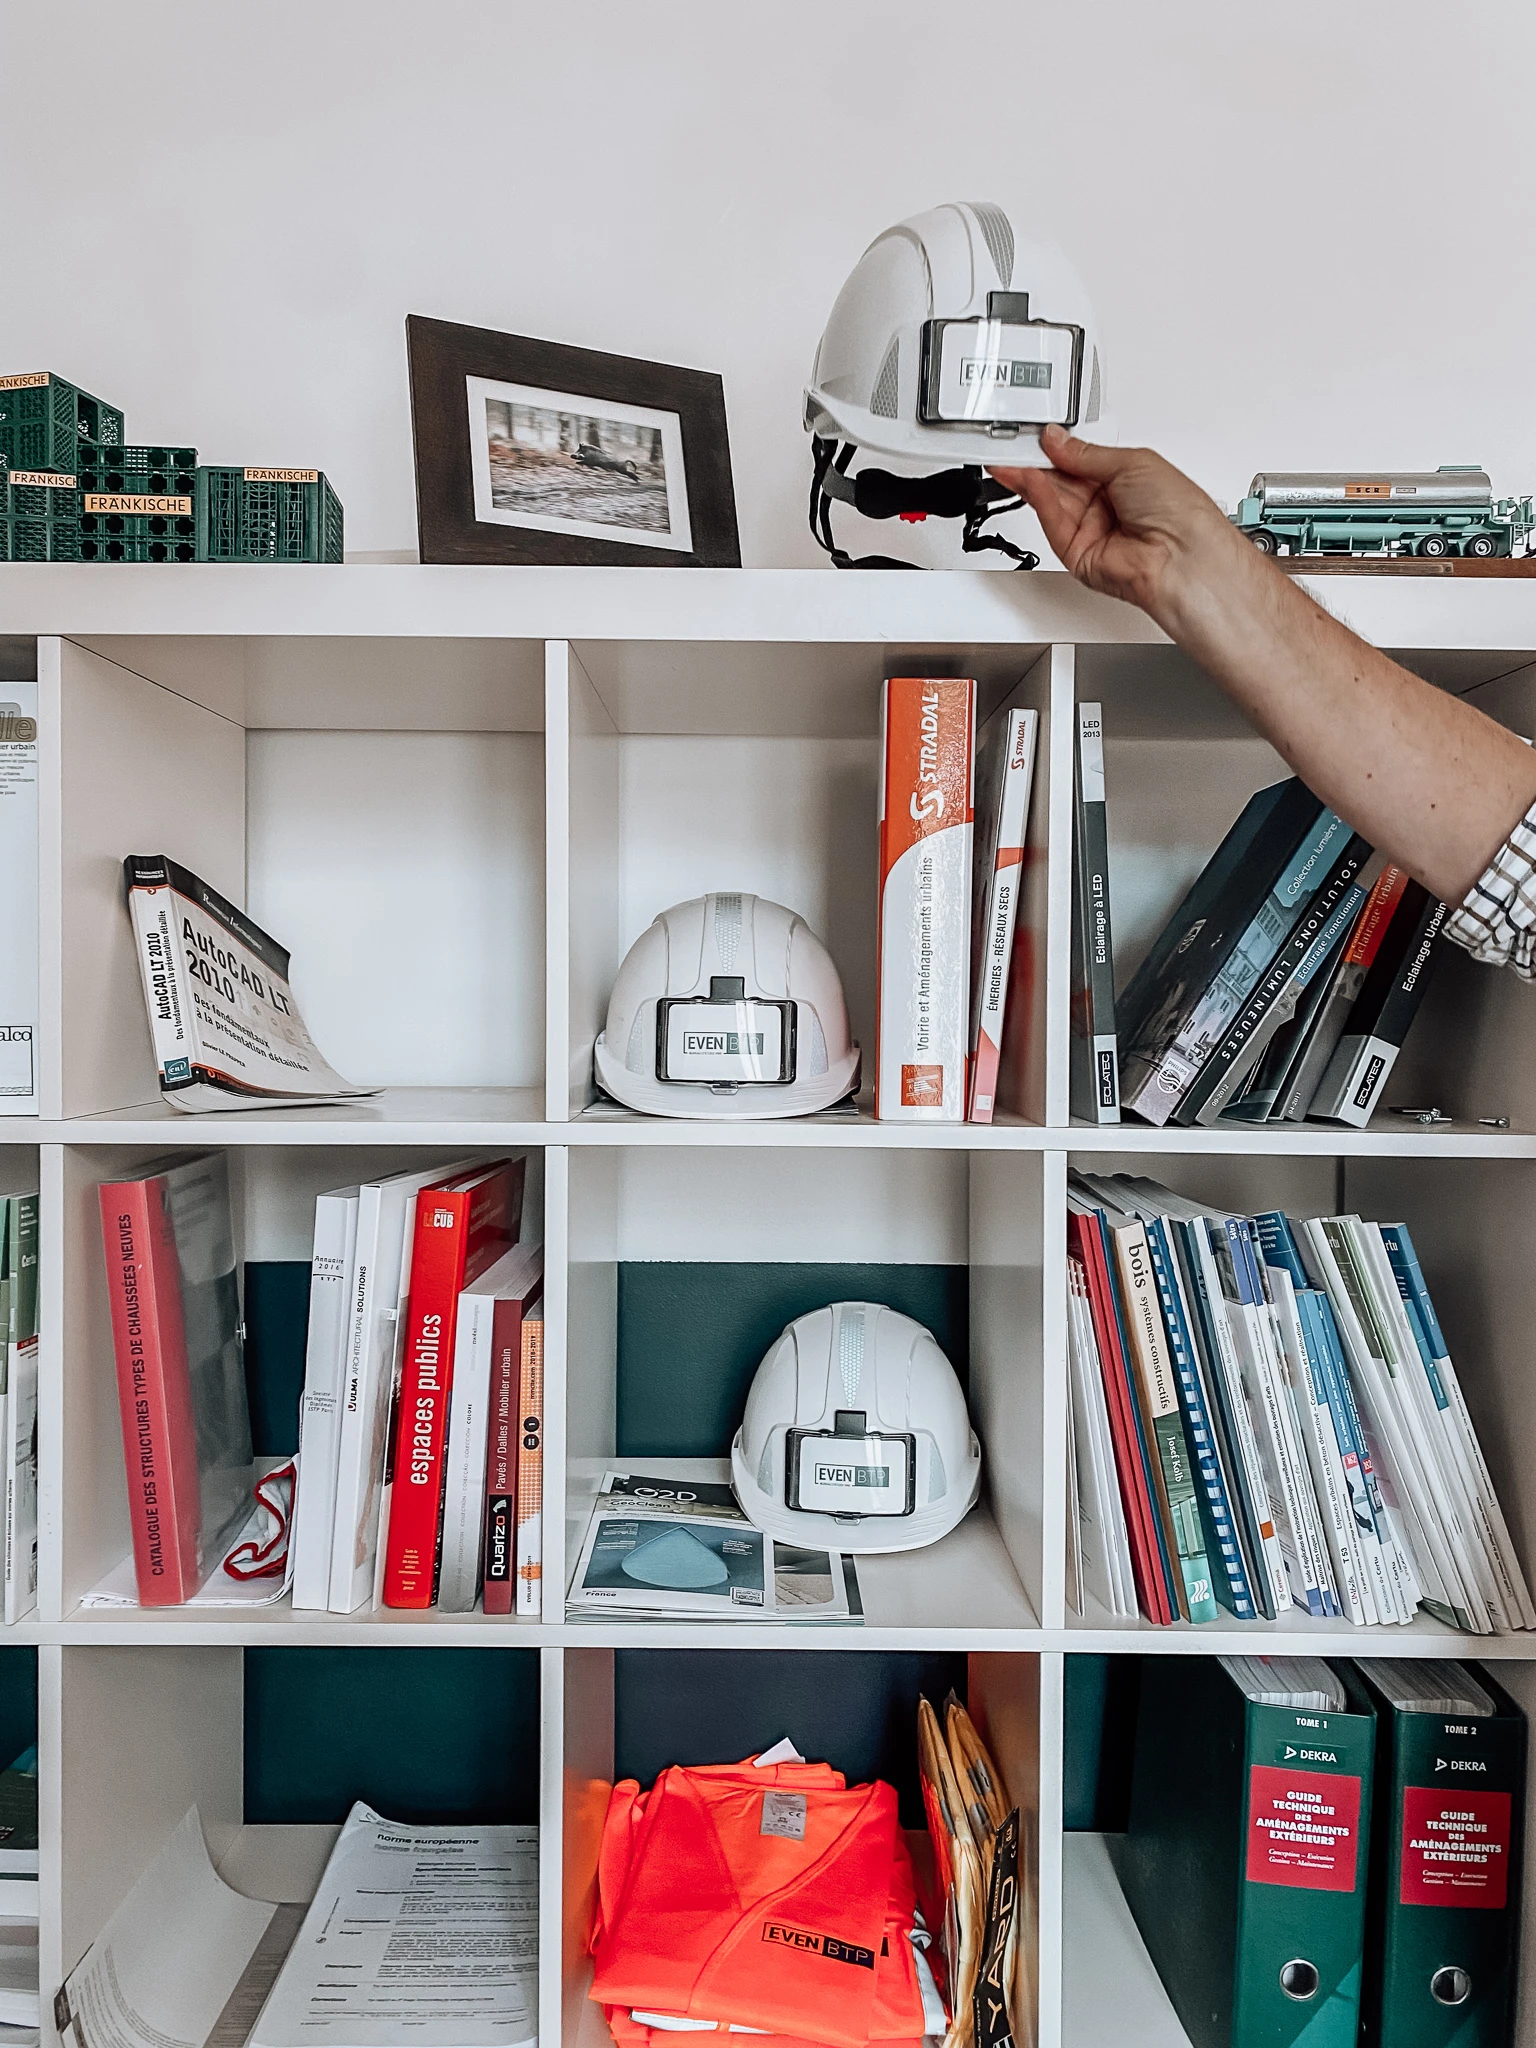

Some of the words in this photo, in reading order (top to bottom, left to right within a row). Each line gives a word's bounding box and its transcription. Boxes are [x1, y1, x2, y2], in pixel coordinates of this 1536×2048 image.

[0, 376, 46, 388] ÄNKISCHE
[965, 363, 1008, 381] EVEN
[1013, 365, 1048, 382] BTP
[246, 469, 314, 481] FRÄNKISCHE
[90, 497, 186, 512] FRÄNKISCHE
[1083, 721, 1100, 729] LED
[919, 692, 939, 784] STRADAL
[1015, 720, 1026, 756] STRADAL
[1287, 853, 1318, 895] Collection
[1314, 823, 1337, 855] lumière
[920, 857, 933, 901] urbains
[1092, 874, 1103, 899] LED
[999, 886, 1011, 910] SECS
[1093, 900, 1105, 908] à
[1294, 859, 1357, 949] SOLUTIONS
[1353, 908, 1381, 960] Eclairage
[1376, 868, 1399, 906] Urbain
[146, 933, 163, 957] 2010
[992, 913, 1008, 956] RÉSEAUX
[1095, 910, 1106, 964] Eclairage
[1297, 938, 1327, 980] Eclairage
[1324, 888, 1362, 938] Fonctionnel
[917, 906, 934, 997] Aménagements
[1402, 940, 1431, 992] Eclairage
[1424, 902, 1447, 938] Urbain
[150, 959, 165, 971] LT
[183, 917, 264, 998] AutoCAD
[268, 986, 290, 1016] LT
[186, 950, 235, 1003] 2010
[153, 974, 172, 1019] AutoCAD
[986, 965, 1003, 1012] ÉNERGIES
[170, 984, 183, 1028] fondamentaux
[918, 1001, 930, 1012] et
[1222, 961, 1291, 1061] LUMINEUSES
[194, 993, 210, 1010] Des
[212, 1004, 270, 1048] fondamentaux
[196, 1007, 203, 1019] à
[204, 1012, 214, 1025] la
[215, 1020, 267, 1057] présentation
[917, 1013, 930, 1051] Voirie
[176, 1028, 184, 1040] Des
[688, 1036, 723, 1049] EVEN
[1102, 1053, 1112, 1105] ECLATEC
[1167, 1060, 1188, 1077] PHILIPS
[1358, 1060, 1382, 1106] ECLATEC
[433, 1213, 454, 1228] CUB
[119, 1214, 135, 1261] NEUVES
[1329, 1236, 1340, 1248] rtu
[1385, 1240, 1399, 1251] rtu
[122, 1264, 142, 1336] CHAUSSÉES
[356, 1266, 367, 1313] SOLUTIONS
[1128, 1242, 1147, 1289] bois
[1141, 1296, 1156, 1344] systèmes
[1150, 1346, 1169, 1410] constructifs
[130, 1339, 144, 1355] DE
[352, 1315, 364, 1375] ARCHITECTURAL
[1294, 1322, 1306, 1357] réalisation
[415, 1314, 442, 1391] publics
[501, 1348, 511, 1377] urbain
[132, 1359, 147, 1397] TYPES
[350, 1378, 359, 1402] ULMA
[1303, 1367, 1317, 1406] Conception
[498, 1379, 510, 1417] Mobilier
[1268, 1399, 1278, 1420] ouvrages
[136, 1399, 155, 1478] STRUCTURES
[410, 1396, 434, 1485] espaces
[497, 1425, 508, 1453] Dalles
[1274, 1430, 1283, 1451] entretien
[1313, 1413, 1325, 1445] désactivé
[1166, 1436, 1178, 1460] Josef
[1320, 1446, 1329, 1466] béton
[495, 1462, 507, 1489] Pavés
[819, 1467, 852, 1482] EVEN
[857, 1470, 886, 1483] BTP
[1171, 1460, 1184, 1483] Kolb
[1326, 1467, 1331, 1476] en
[144, 1481, 157, 1506] DES
[1326, 1477, 1337, 1502] urbains
[610, 1500, 671, 1509] GeoClean
[1332, 1503, 1343, 1530] Espaces
[146, 1508, 164, 1576] CATALOGUE
[491, 1515, 506, 1576] Quartzo
[1310, 1534, 1319, 1553] risques
[1340, 1547, 1348, 1556] 53
[1298, 1540, 1310, 1569] d'application
[1373, 1556, 1382, 1576] Certu
[1274, 1569, 1284, 1593] Cerema
[1305, 1569, 1313, 1583] Guide
[1390, 1561, 1400, 1581] Certu
[1296, 1717, 1320, 1728] TOME
[1322, 1720, 1328, 1729] 1
[1444, 1725, 1468, 1734] TOME
[1470, 1727, 1477, 1735] 2
[1300, 1750, 1337, 1763] DEKRA
[1451, 1760, 1487, 1771] DEKRA
[1272, 1800, 1335, 1815] TECHNIQUE
[1286, 1791, 1322, 1803] GUIDE
[1256, 1818, 1350, 1836] AMÉNAGEMENTS
[1294, 1813, 1312, 1821] DES
[1426, 1820, 1488, 1833] TECHNIQUE
[1440, 1811, 1475, 1821] GUIDE
[377, 1833, 412, 1844] norme
[414, 1838, 480, 1846] européenne
[1269, 1830, 1335, 1845] EXTÉRIEURS
[1410, 1838, 1502, 1853] AMÉNAGEMENTS
[1268, 1848, 1300, 1858] Conception
[1268, 1856, 1290, 1864] Gestion
[1423, 1850, 1488, 1863] EXTÉRIEURS
[769, 1926, 820, 1949] EVEN
[827, 1941, 869, 1962] BTP
